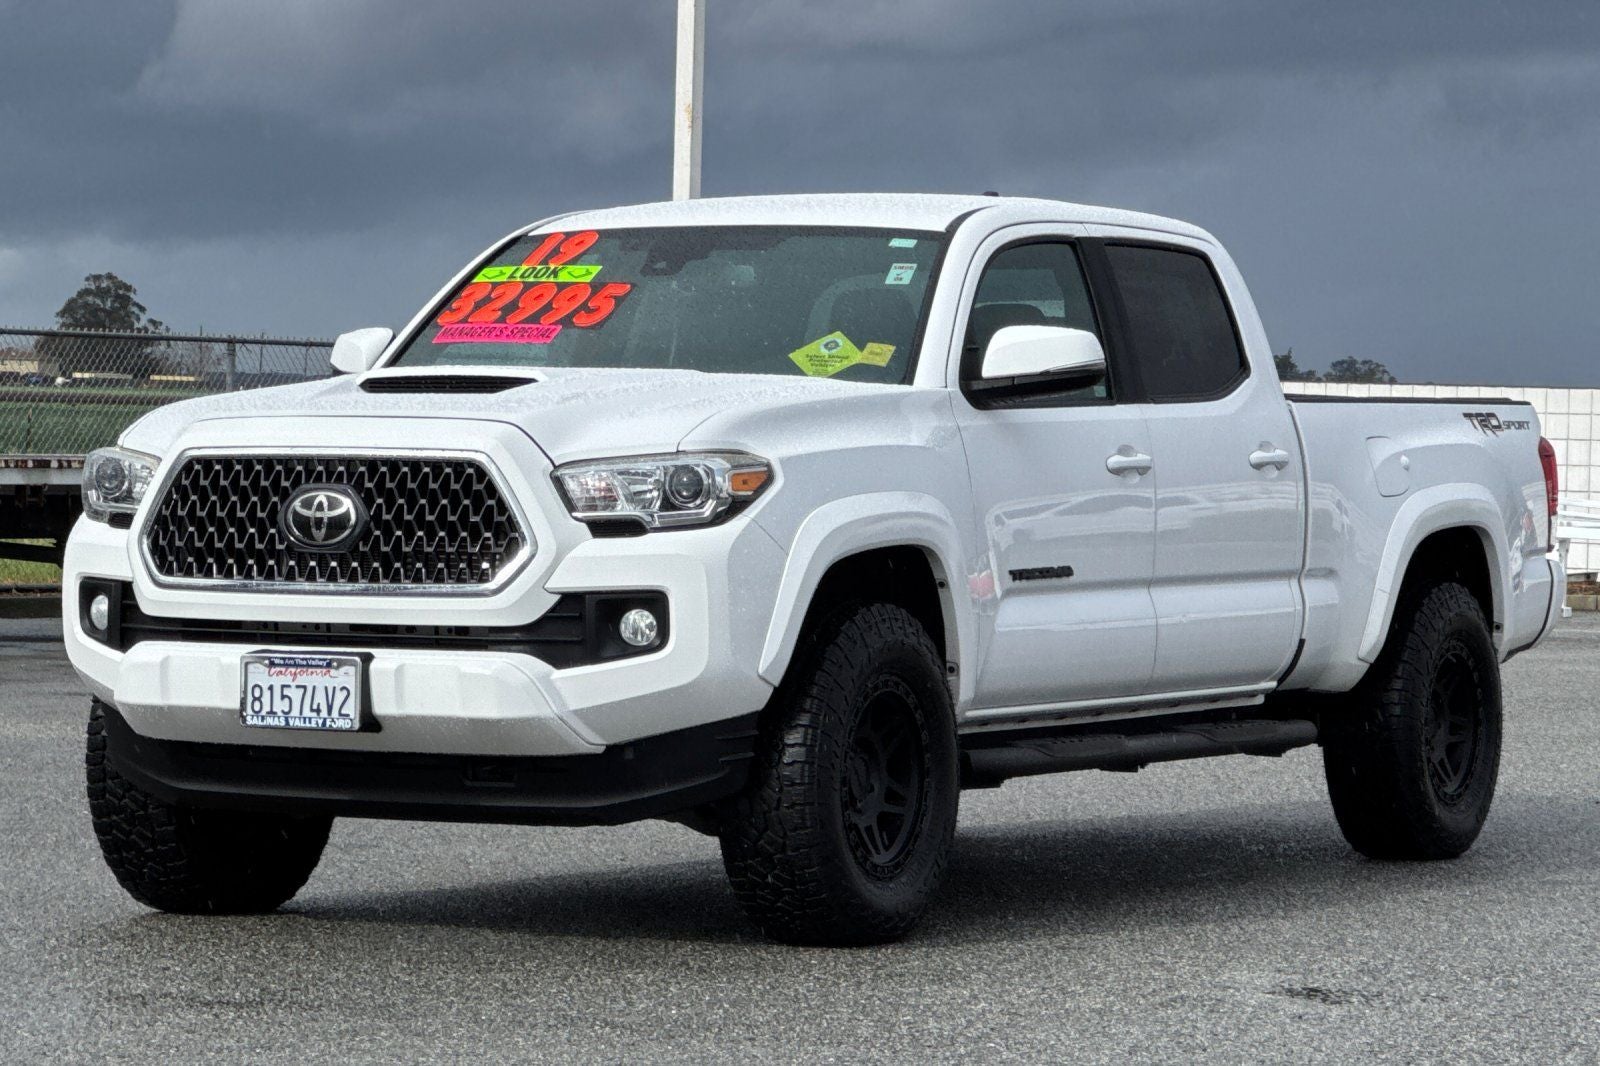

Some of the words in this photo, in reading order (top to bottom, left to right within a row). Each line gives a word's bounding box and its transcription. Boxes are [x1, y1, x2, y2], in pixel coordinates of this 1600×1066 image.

[522, 231, 599, 266] 19
[508, 266, 566, 279] LOOK
[437, 282, 631, 327] 32995
[505, 326, 557, 339] SPECIAL
[1462, 413, 1504, 437] TRD
[1502, 421, 1530, 430] SPORT
[268, 666, 339, 682] California
[251, 683, 351, 718] 81574V2
[288, 716, 324, 728] VALLEY
